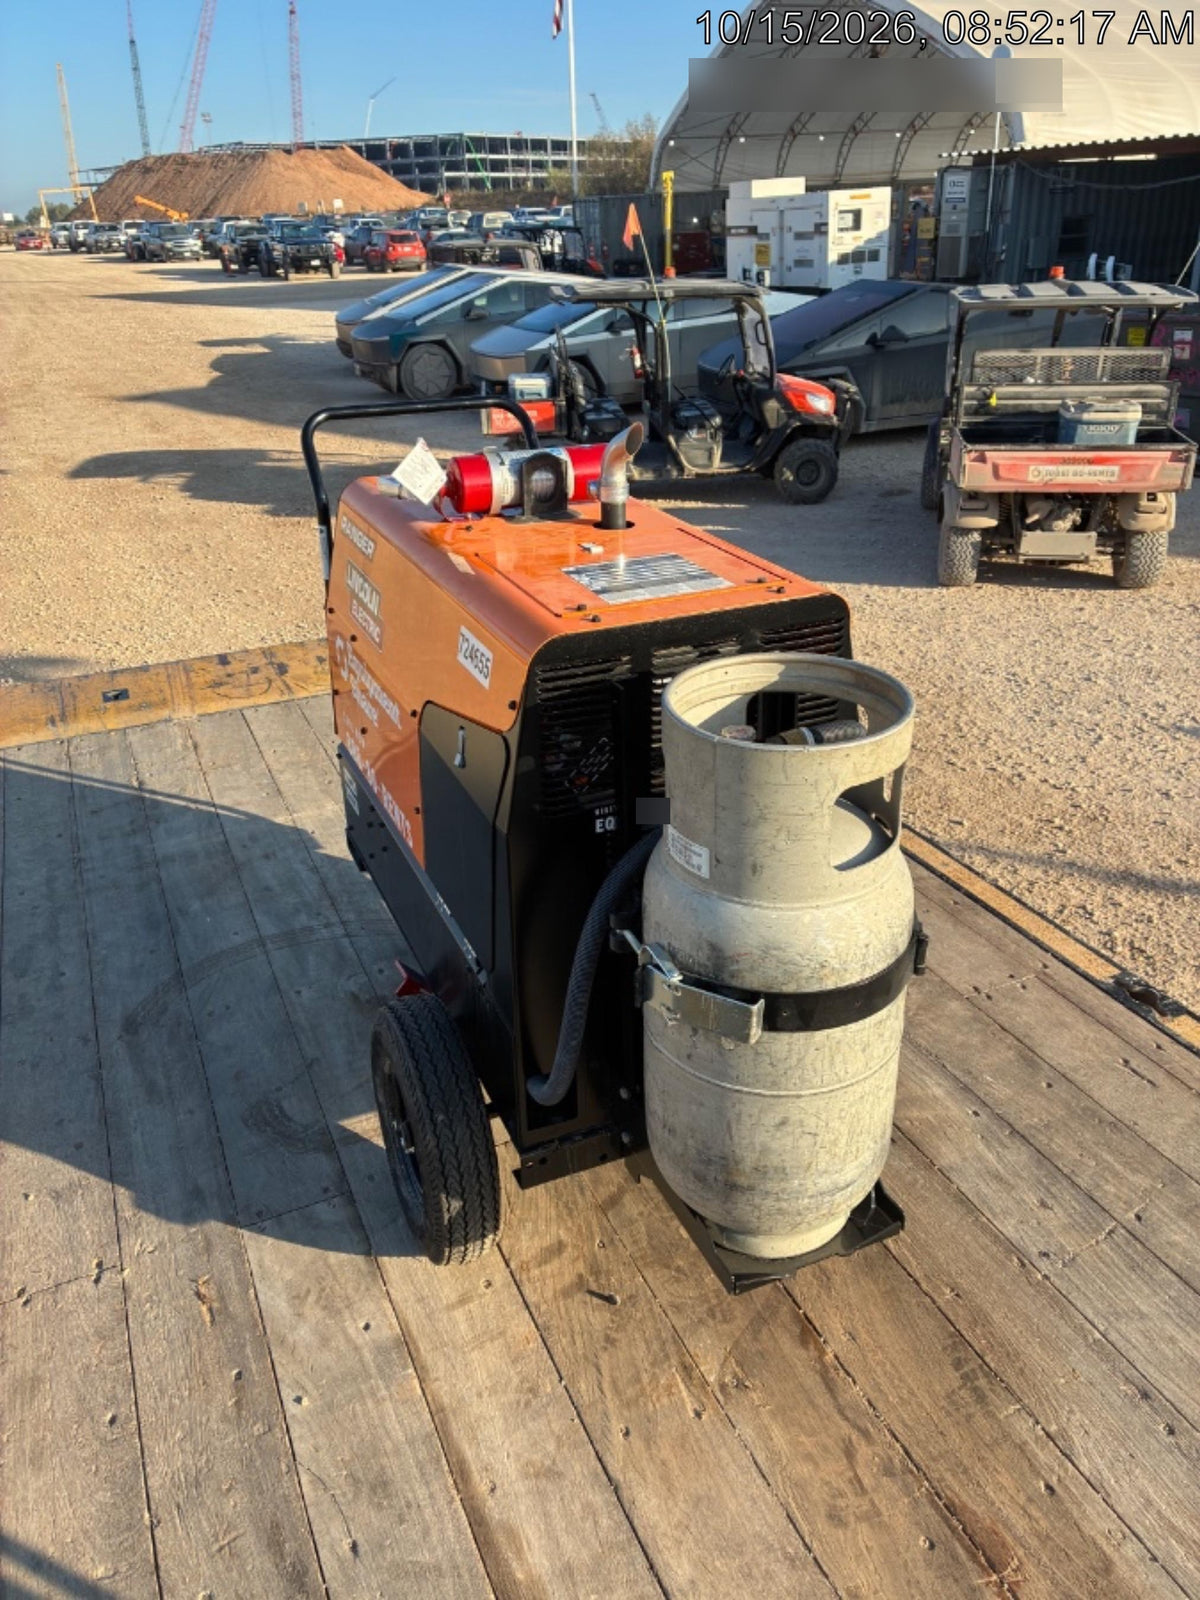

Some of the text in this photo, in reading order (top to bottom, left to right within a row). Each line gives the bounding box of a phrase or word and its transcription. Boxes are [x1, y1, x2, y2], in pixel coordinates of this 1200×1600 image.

[341, 514, 375, 560] RANGER
[347, 562, 380, 617] LINCOLN
[351, 599, 381, 644] ELECTRIC
[459, 632, 491, 680] 724655
